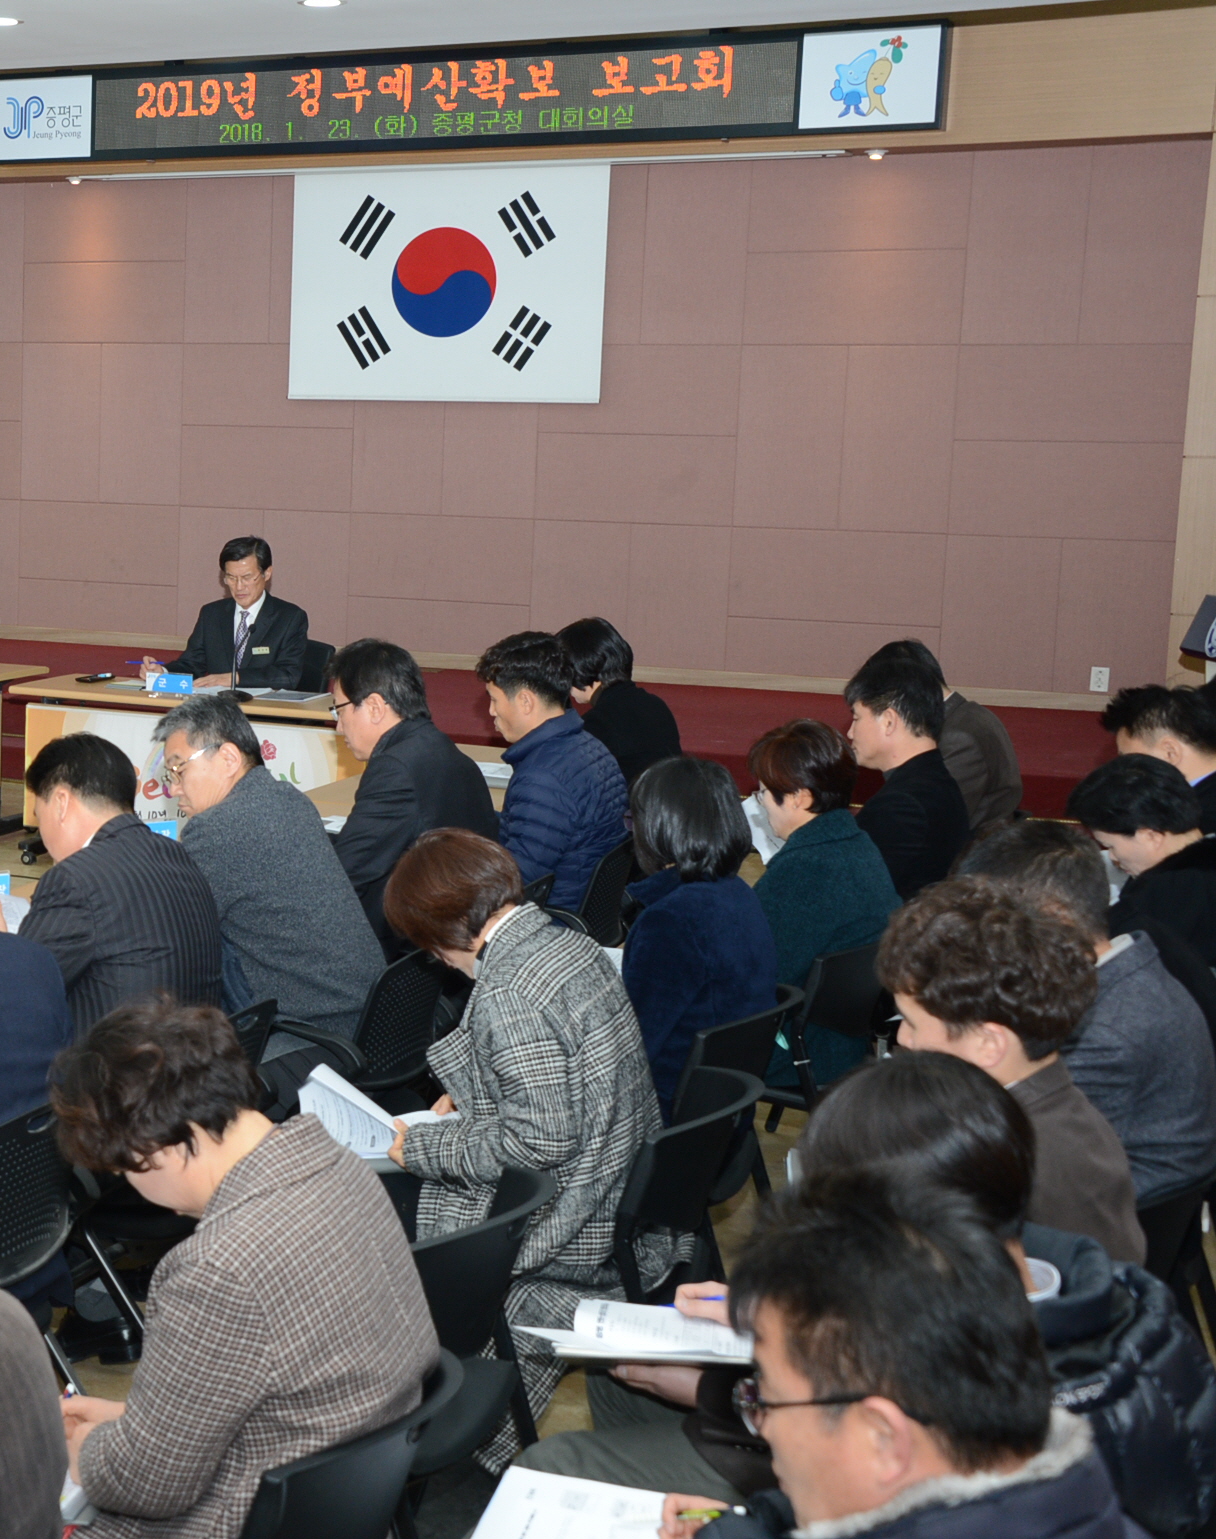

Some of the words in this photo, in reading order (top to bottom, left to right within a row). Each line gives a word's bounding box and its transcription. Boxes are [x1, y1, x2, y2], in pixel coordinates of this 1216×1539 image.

[135, 72, 257, 120] 2019년
[286, 58, 560, 117] 정부예산확보
[592, 45, 734, 98] 보고회
[45, 105, 82, 128] 증평군
[219, 122, 271, 144] 2018.
[374, 114, 418, 138] (화)
[432, 109, 523, 137] 증평군청
[538, 104, 634, 132] 대회의실
[32, 130, 53, 140] Jeung
[55, 130, 82, 140] Pyeong
